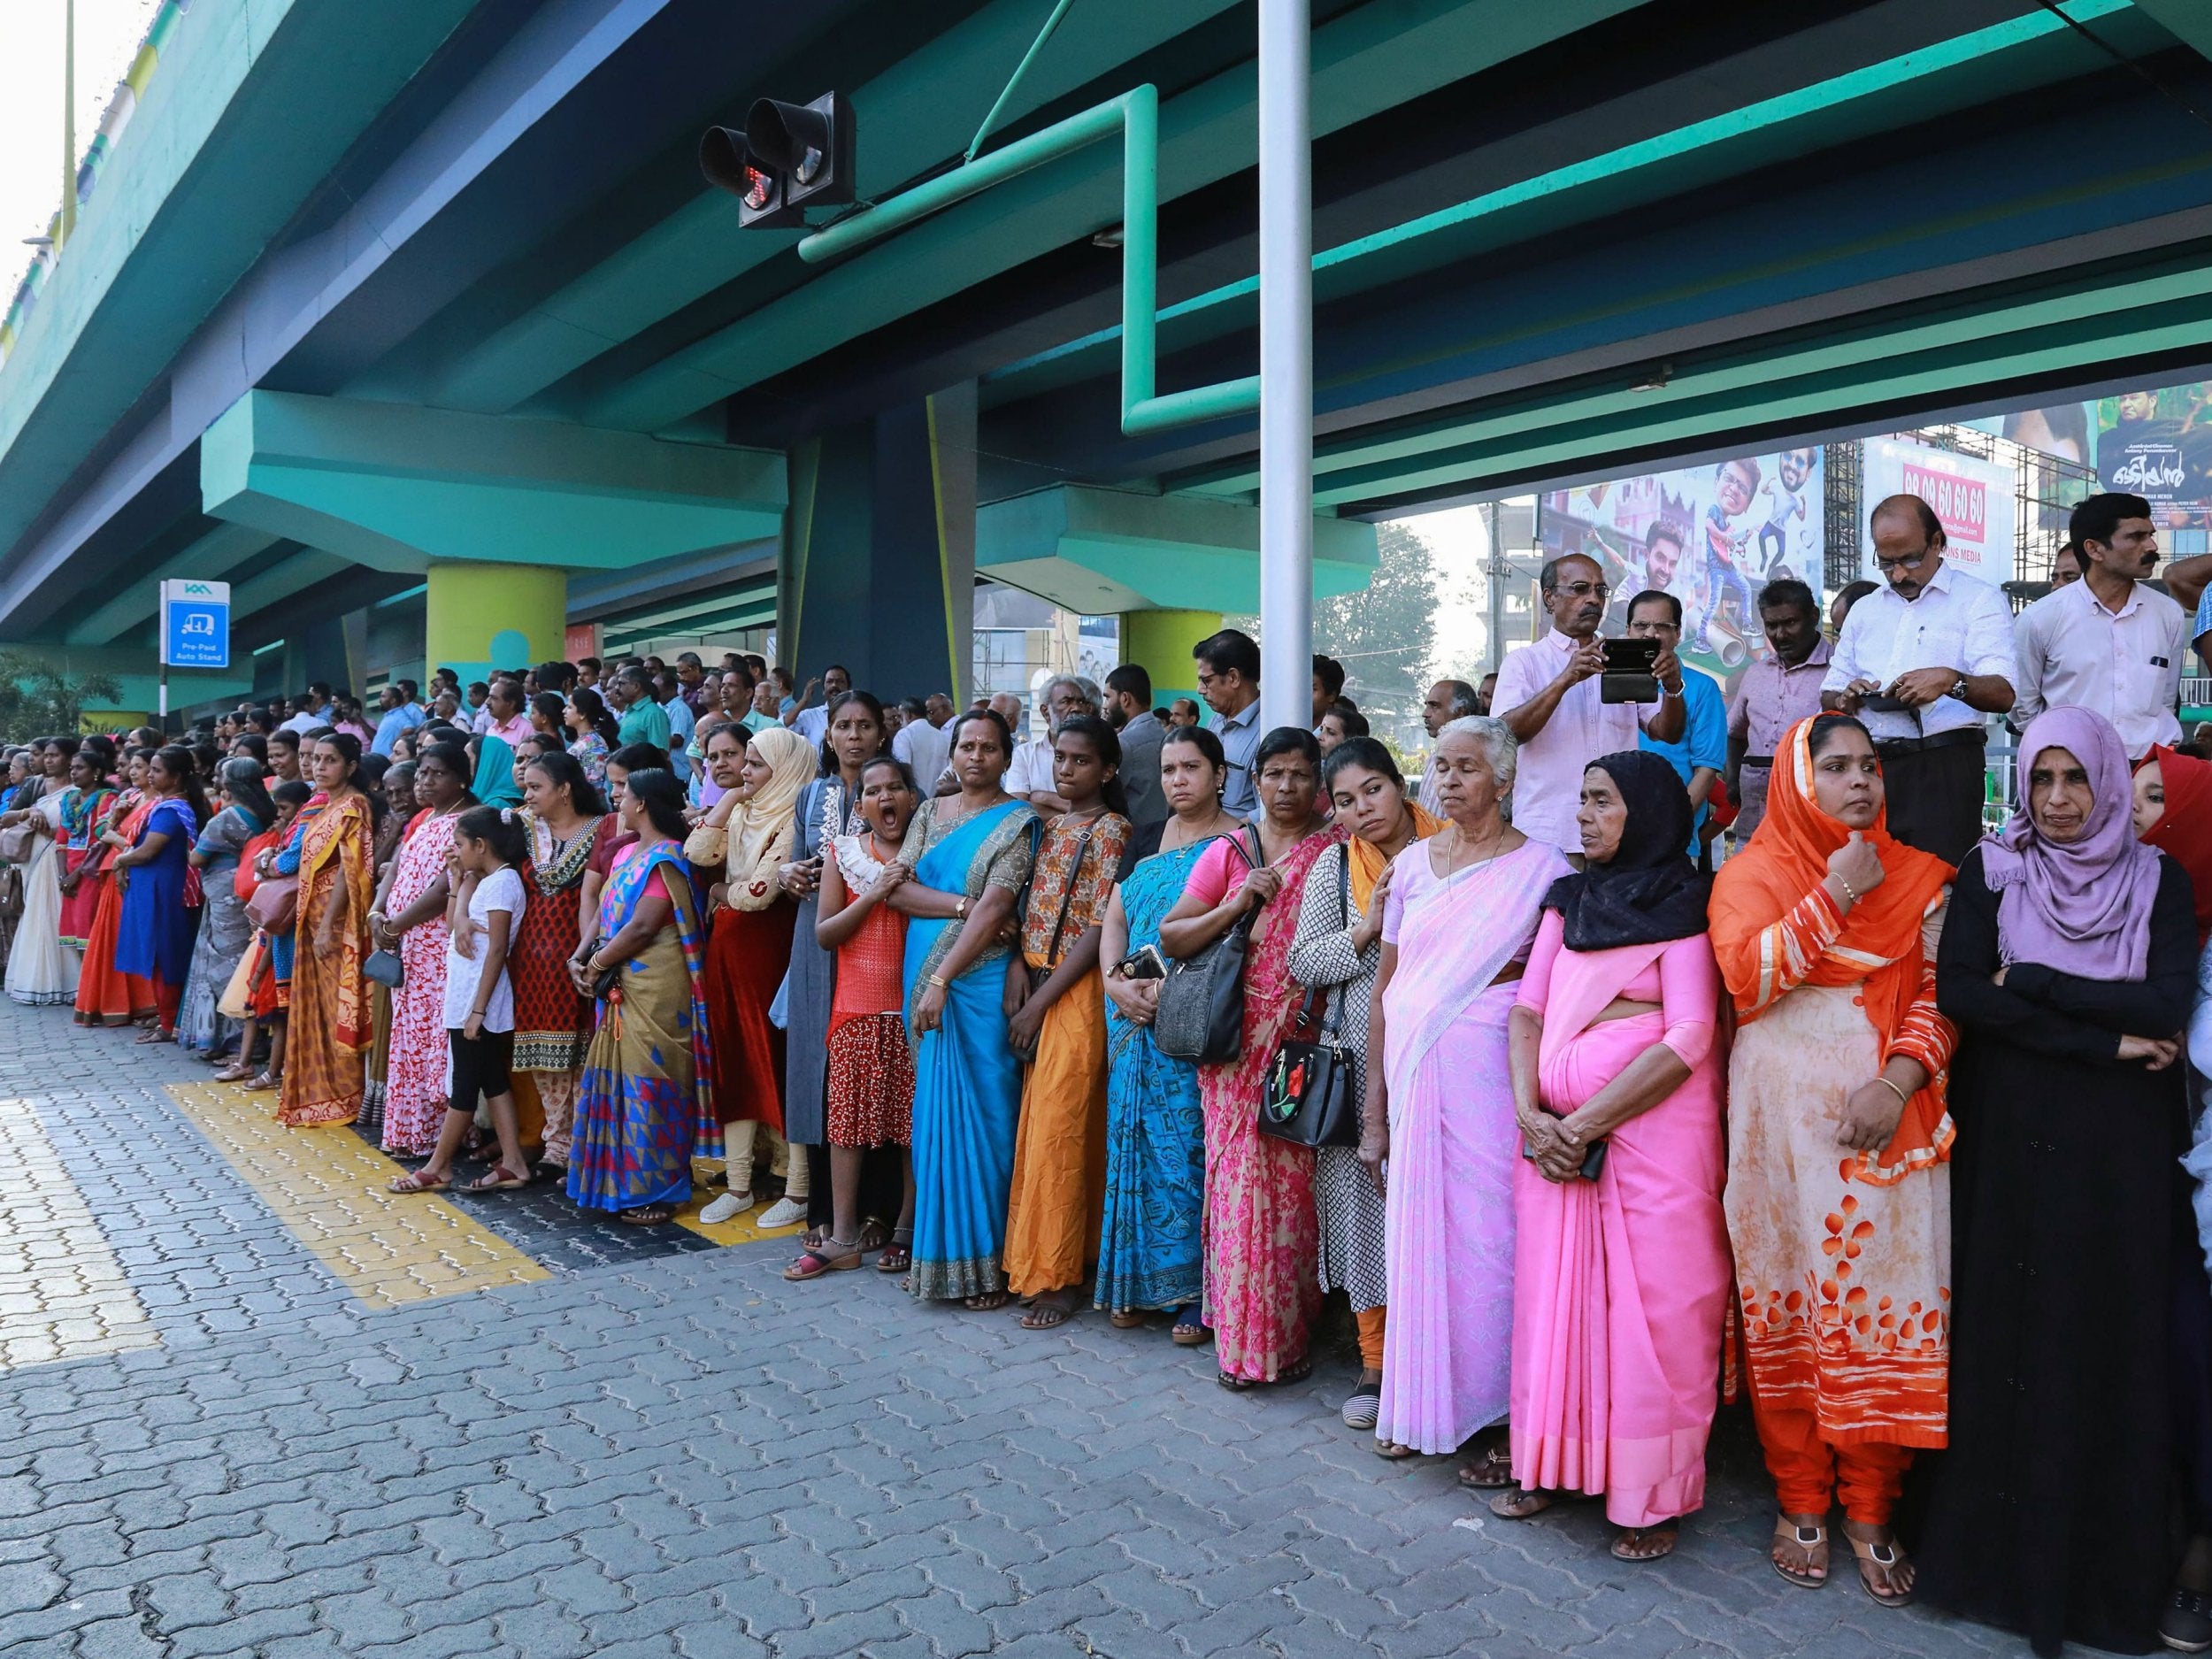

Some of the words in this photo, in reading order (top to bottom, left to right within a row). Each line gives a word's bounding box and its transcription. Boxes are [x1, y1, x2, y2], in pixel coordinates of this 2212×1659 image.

[1938, 480, 1952, 518] 60
[1955, 484, 1967, 521] 60
[1970, 488, 1983, 525] 60
[1961, 549, 1982, 563] MEDIA
